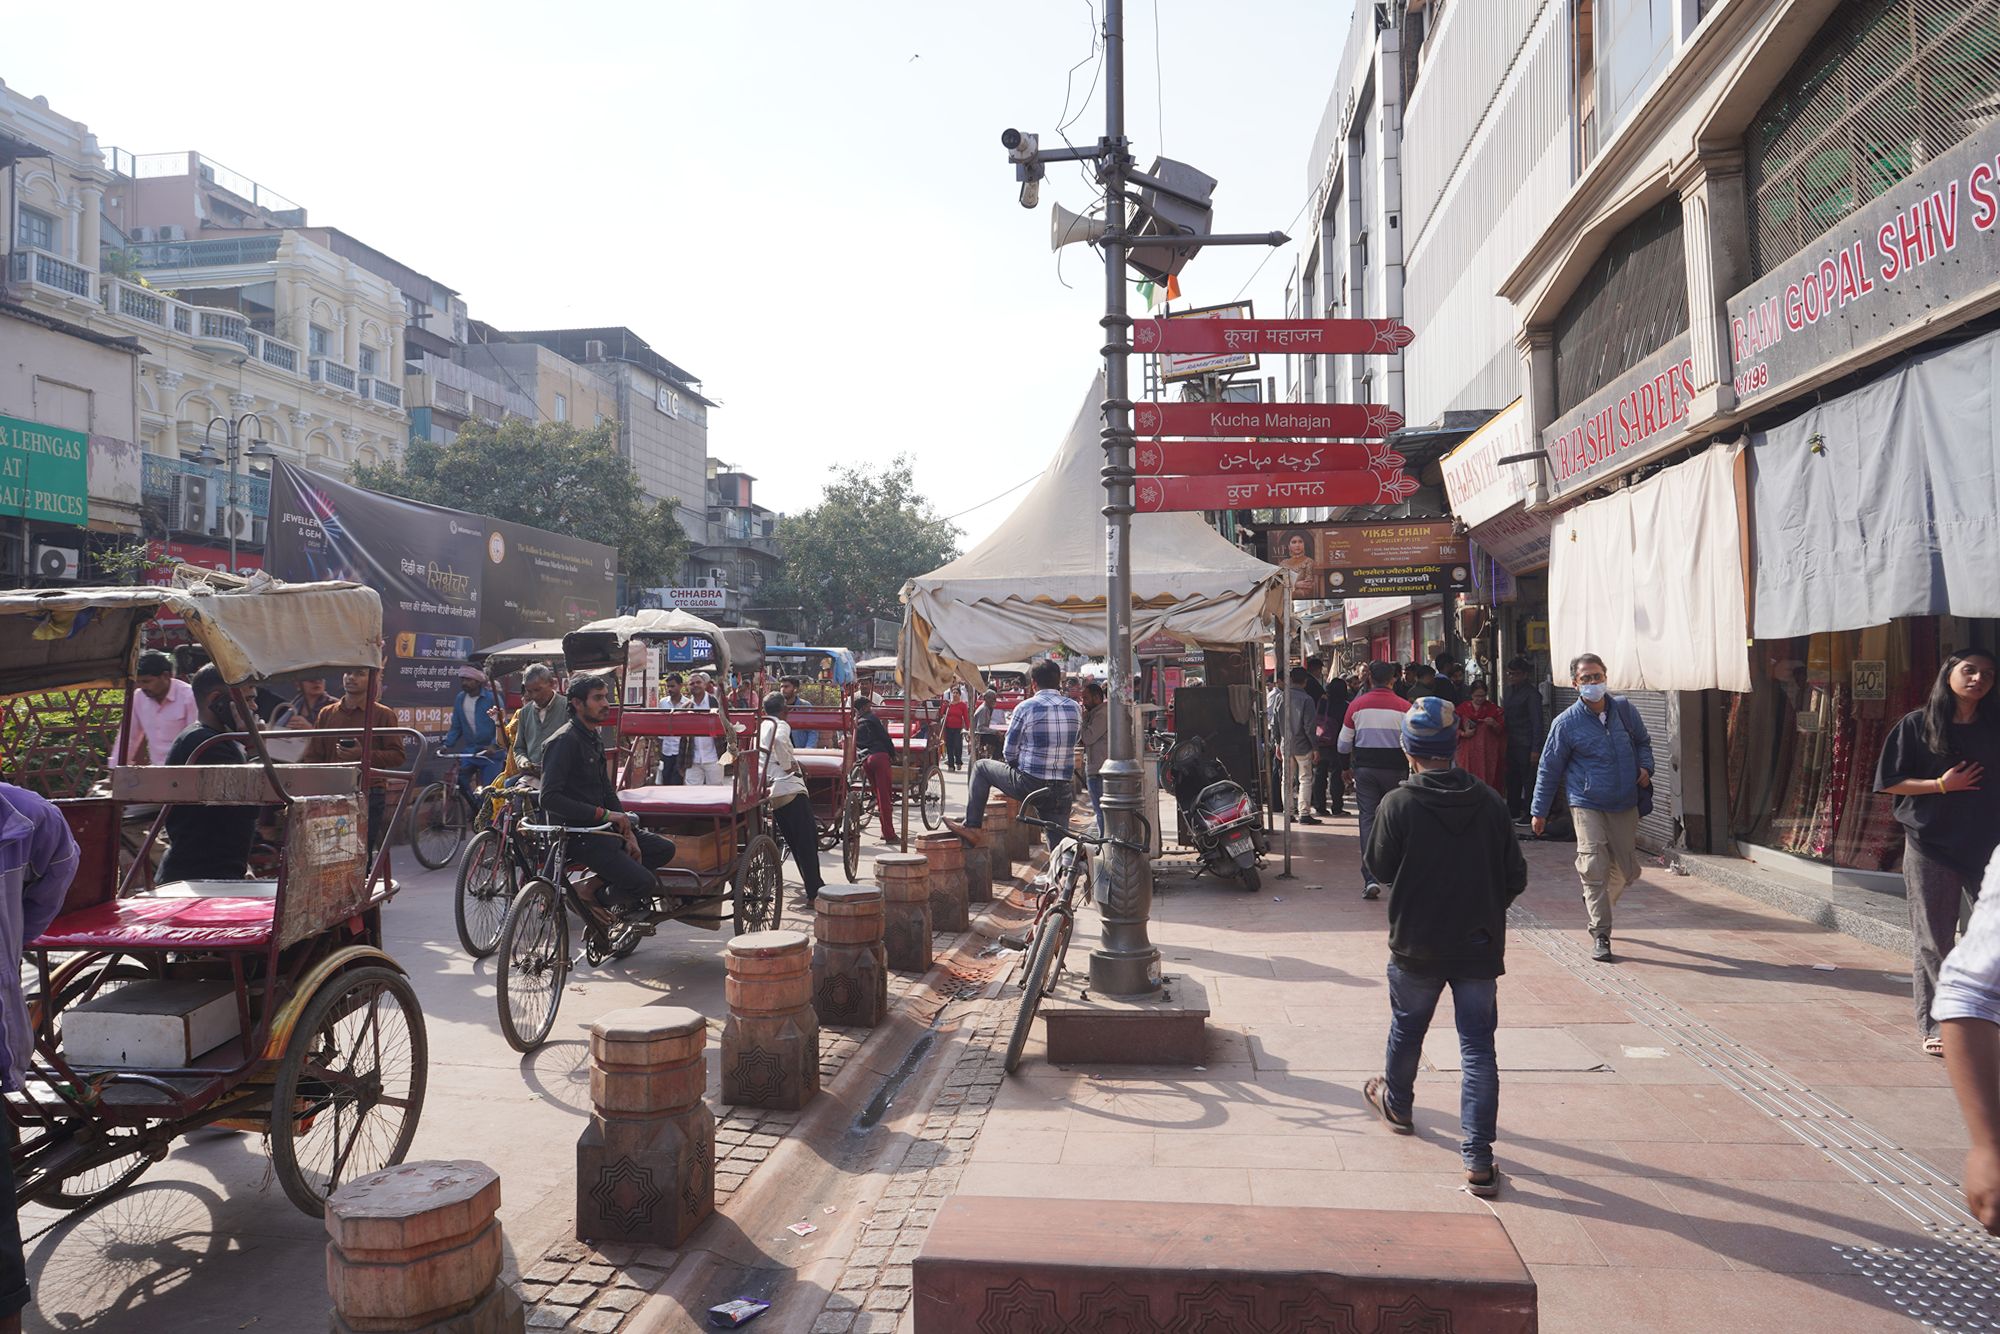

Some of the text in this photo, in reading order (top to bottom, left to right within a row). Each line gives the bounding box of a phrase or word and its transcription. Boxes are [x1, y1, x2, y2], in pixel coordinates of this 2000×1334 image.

[1732, 152, 2000, 364] RAM GOPAL SHIV S
[1223, 328, 1324, 349] कूचा महाजन
[659, 385, 679, 416] CTC
[1618, 356, 1696, 449] SAREES
[1210, 412, 1331, 431] Kucha Mahajan
[11, 428, 81, 461] LEHNGAS
[2, 456, 22, 478] AT
[1266, 480, 1325, 498] ਮਹਾਜਨ
[0, 484, 83, 516] ALE PRICES
[305, 528, 321, 539] GEM
[1361, 527, 1431, 538] VIKAS CHAIN
[416, 564, 425, 576] का
[1364, 576, 1386, 586] कूचा
[669, 589, 723, 599] CHHABRA
[689, 599, 718, 607] GLOBAL
[415, 708, 441, 722] 01-02
